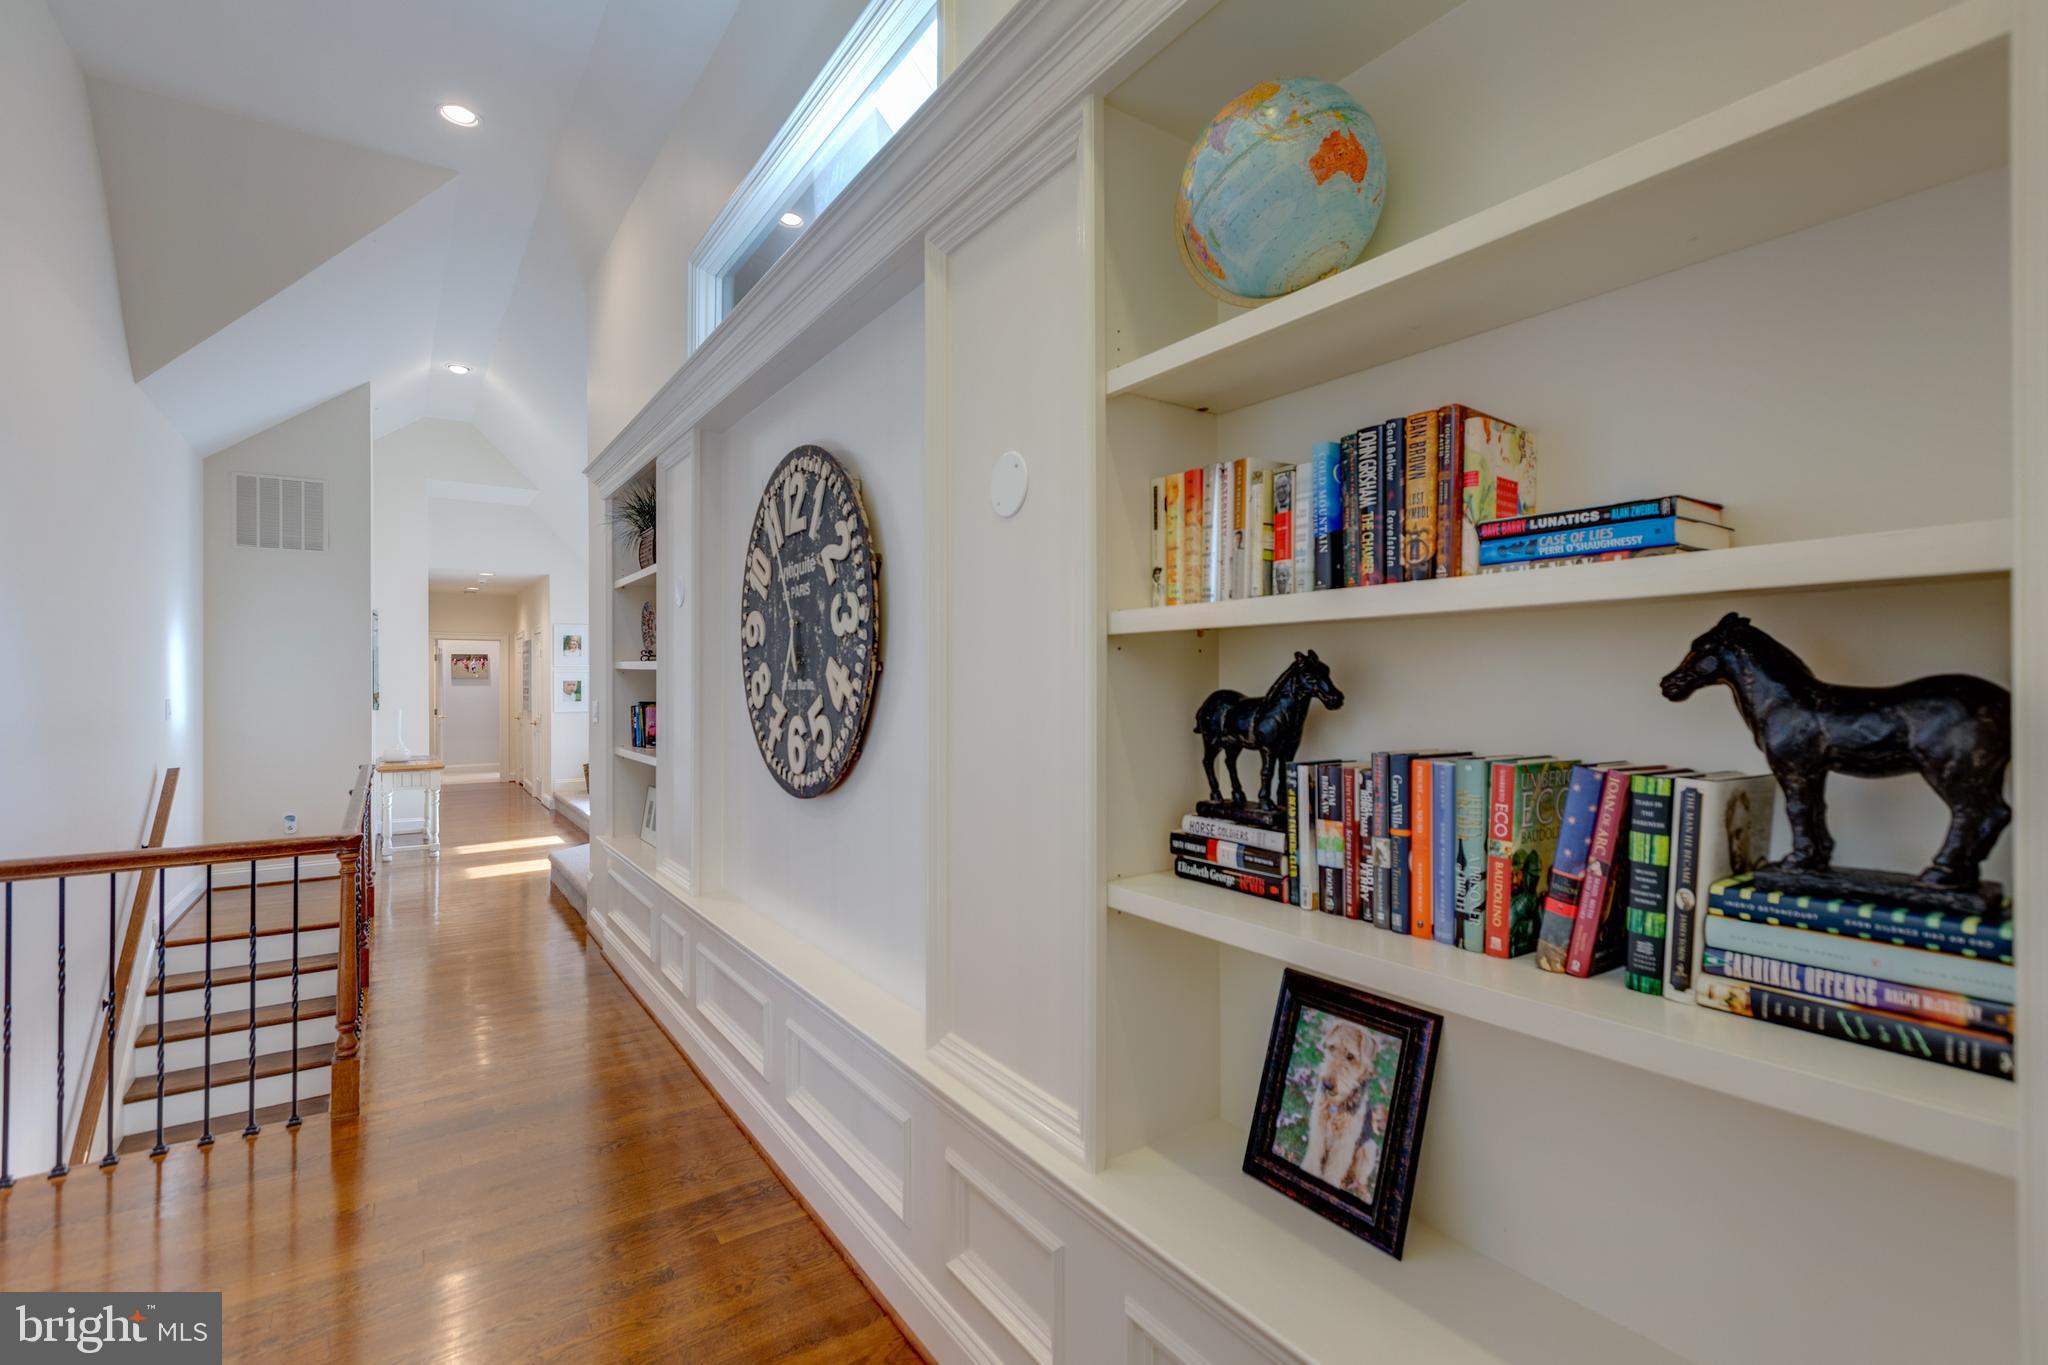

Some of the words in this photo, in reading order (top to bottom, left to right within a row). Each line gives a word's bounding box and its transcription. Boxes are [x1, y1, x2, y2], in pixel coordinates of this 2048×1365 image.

[1358, 430, 1377, 459] JOHN
[1386, 422, 1396, 449] Saul
[1409, 415, 1427, 439] DAN
[1318, 453, 1328, 488] COLD
[1386, 451, 1396, 481] Bellow
[1408, 440, 1427, 481] BROWN
[1359, 459, 1377, 509] GRISHAM
[783, 472, 807, 536] 12
[808, 477, 826, 541] 1
[1318, 490, 1328, 553] MOUNTAIN
[1361, 511, 1374, 531] THE
[1408, 505, 1429, 519] YMBOL
[1529, 511, 1600, 530] LUNATICS
[1611, 505, 1630, 520] ALAN
[763, 493, 784, 557] 11
[1386, 510, 1397, 567] Ravelstein
[1538, 534, 1567, 547] CASE
[1570, 531, 1585, 543] OF
[1588, 528, 1614, 541] LIES
[820, 519, 851, 586] 2
[1361, 532, 1374, 575] CHAMBER
[1538, 544, 1564, 556] PERRI
[1566, 535, 1644, 553] O'SHAUGHNESSY
[751, 547, 772, 600] 10
[745, 610, 766, 648] 9
[831, 592, 860, 637] 3
[751, 662, 772, 709] 8
[825, 656, 854, 712] 4
[768, 691, 788, 751] 7
[807, 694, 833, 761] 5
[787, 715, 807, 775] 6
[1321, 775, 1330, 816] BROKAW
[1328, 784, 1337, 806] TOM
[1391, 774, 1403, 802] Garry
[1603, 776, 1620, 811] JOAN
[1686, 792, 1696, 811] THE
[1189, 820, 1216, 837] HORSE
[1217, 826, 1249, 841] SOLDIERS
[1494, 803, 1509, 838] ECO
[1602, 814, 1611, 826] OF
[1685, 812, 1695, 832] MAN
[1594, 827, 1609, 857] ARC
[1685, 835, 1693, 847] HE
[1177, 861, 1209, 878] Elizabeth
[1209, 868, 1236, 887] George
[1682, 849, 1692, 884] BECAME
[1492, 862, 1504, 928] BAUDOLINO
[1724, 951, 1801, 994] CARDINAL
[1803, 961, 1878, 1006] OFFENSE
